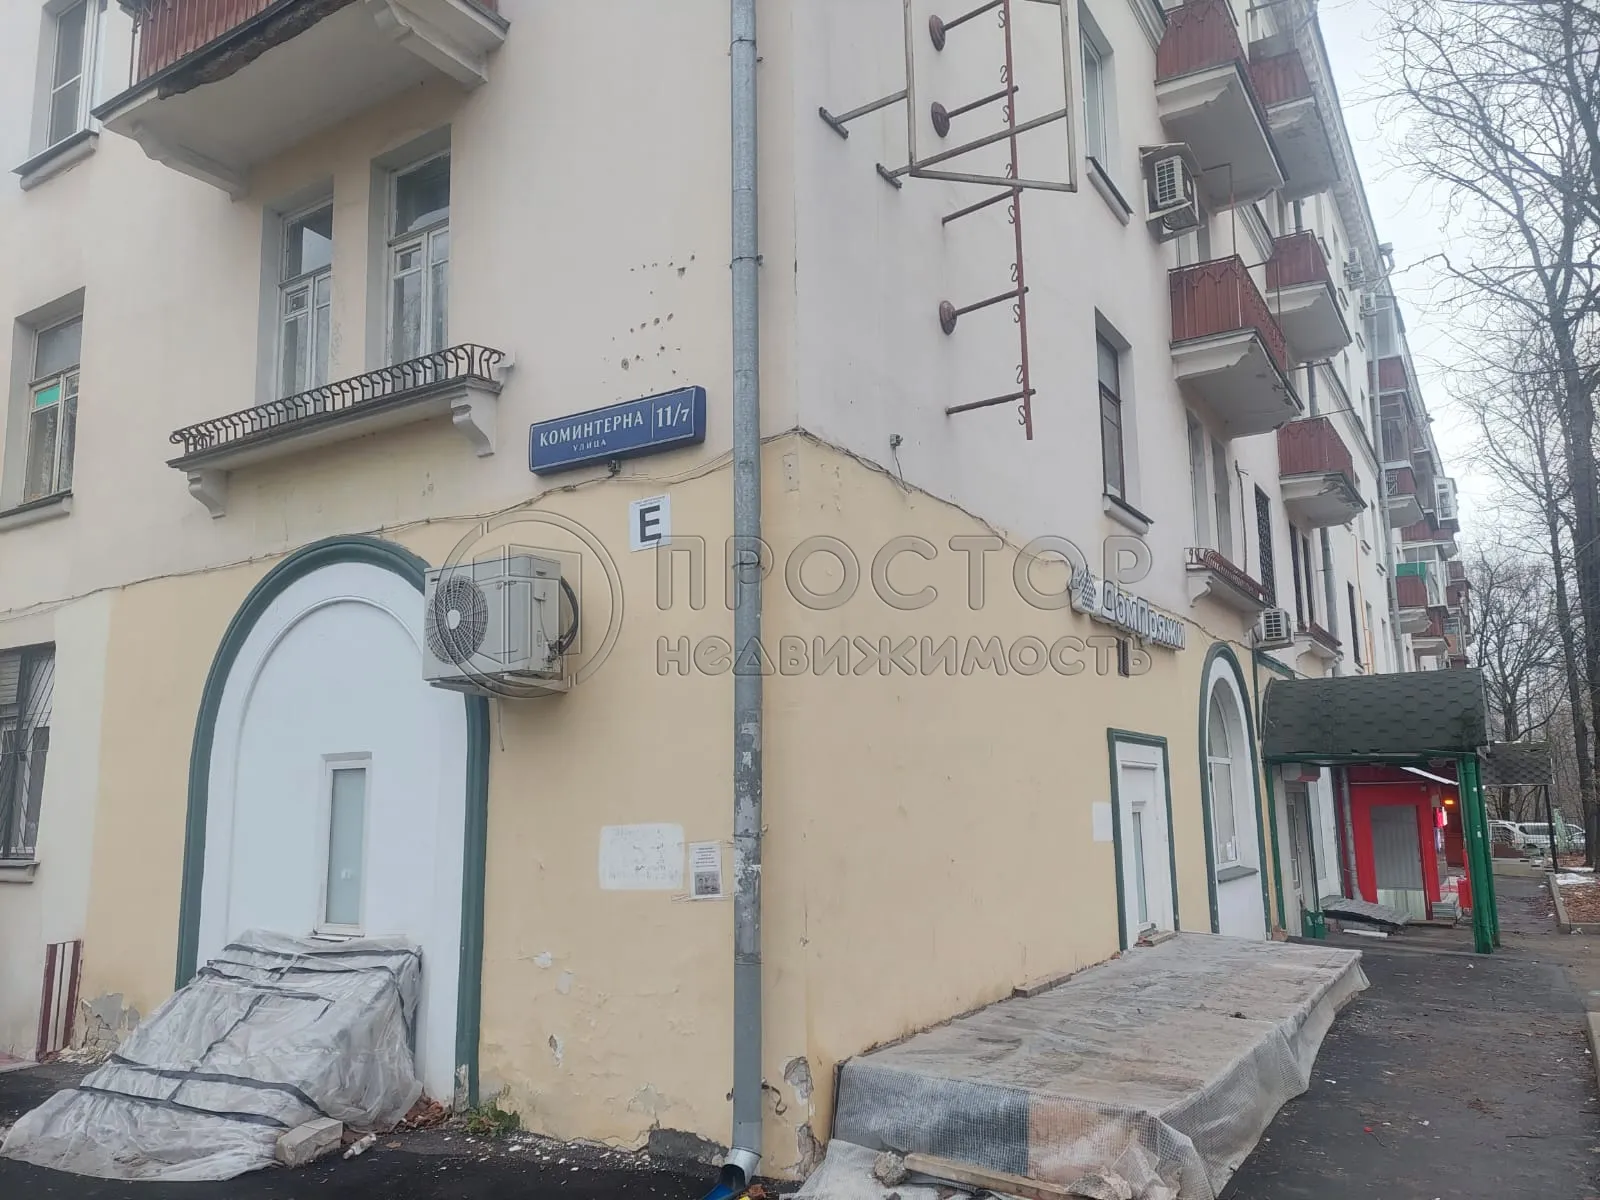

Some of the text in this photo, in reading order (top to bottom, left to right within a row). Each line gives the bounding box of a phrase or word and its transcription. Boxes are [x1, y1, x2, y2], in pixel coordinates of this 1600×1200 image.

[540, 403, 690, 447] КОМИНТЕРНА 11/7
[573, 439, 606, 452] УЛИЦА
[1101, 580, 1185, 650] ДомПряжи
